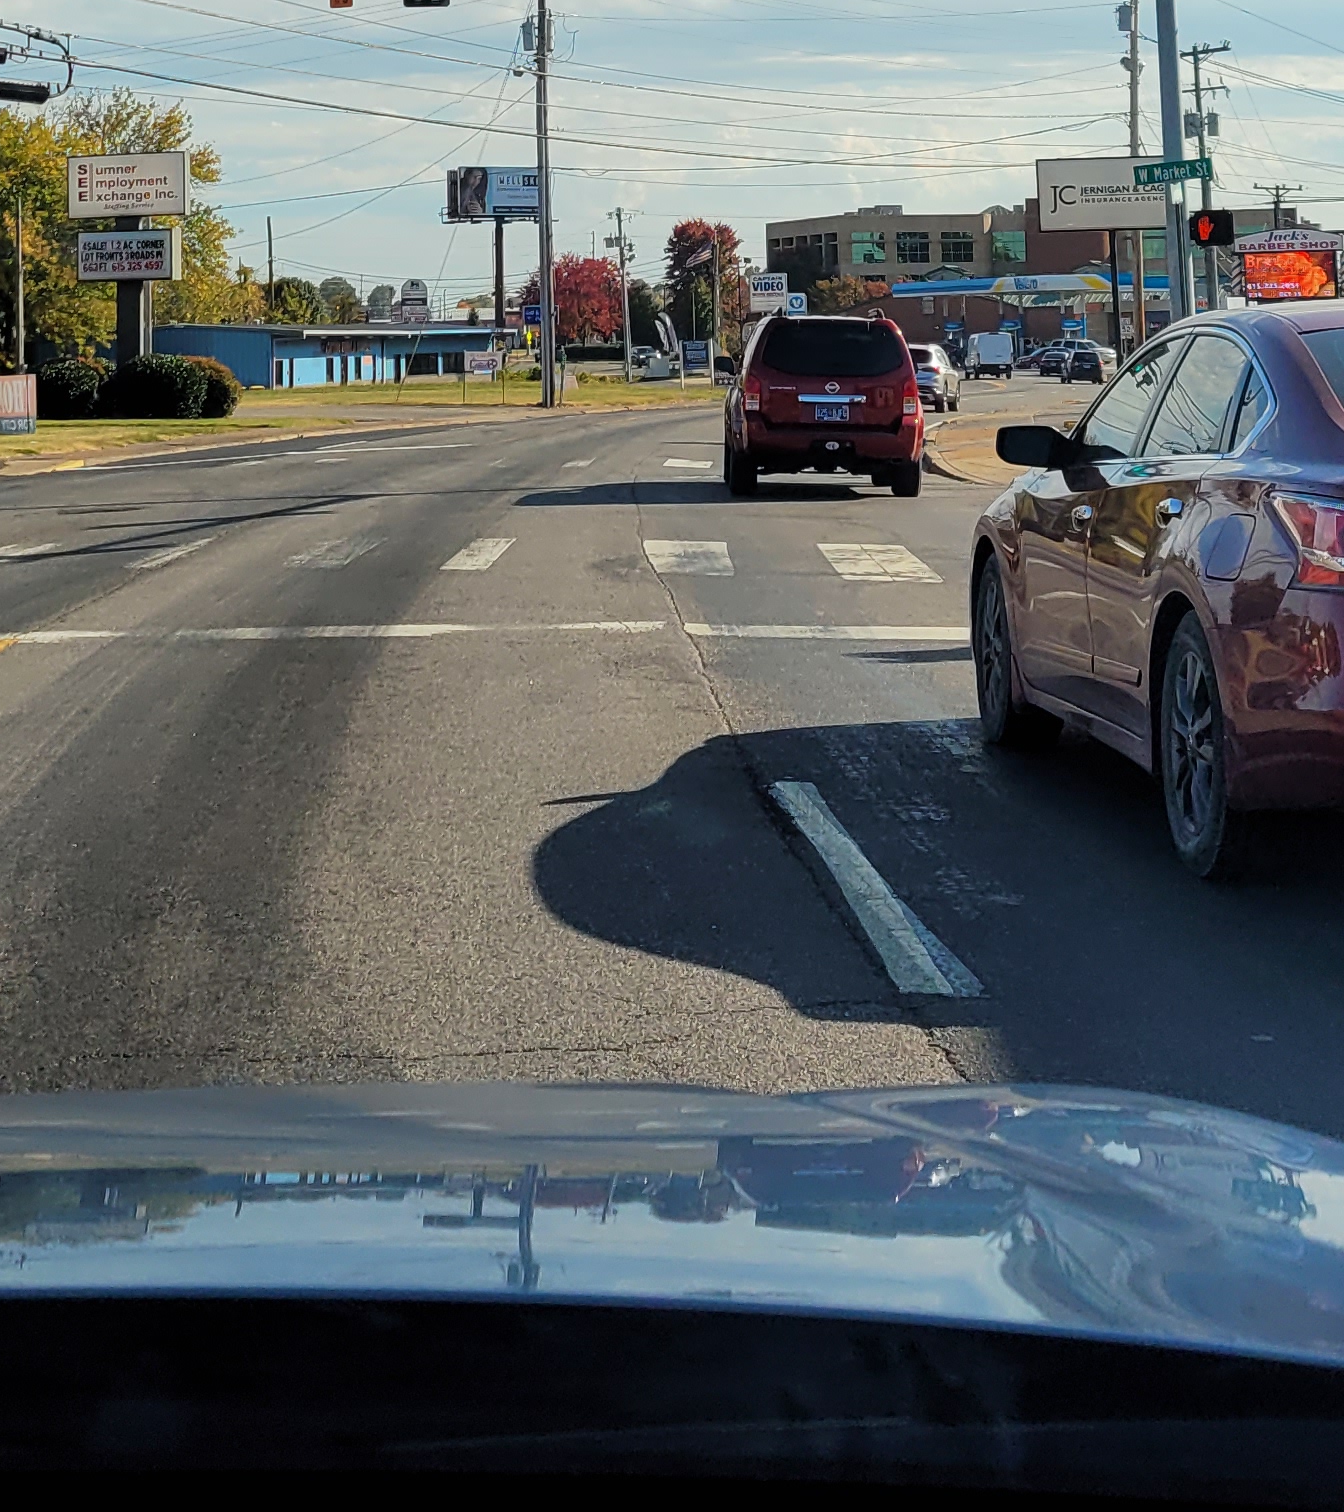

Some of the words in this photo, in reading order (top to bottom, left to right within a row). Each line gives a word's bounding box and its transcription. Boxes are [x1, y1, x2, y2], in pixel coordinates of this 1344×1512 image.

[1138, 168, 1148, 183] W
[1153, 164, 1192, 182] Market
[1196, 161, 1209, 177] St
[154, 189, 179, 200] Inc.
[1080, 185, 1131, 196] JERNIGAN
[1132, 184, 1140, 193] &
[1050, 185, 1077, 214] JC
[1080, 195, 1133, 204] INSURANCE
[1134, 195, 1165, 203] AGENC
[1264, 230, 1310, 243] Jack's
[123, 240, 134, 250] AC
[136, 239, 165, 249] CORNER
[1238, 242, 1295, 251] BARBER
[1299, 240, 1339, 249] SHOP
[80, 251, 95, 263] LOT
[752, 281, 784, 292] VIDEO
